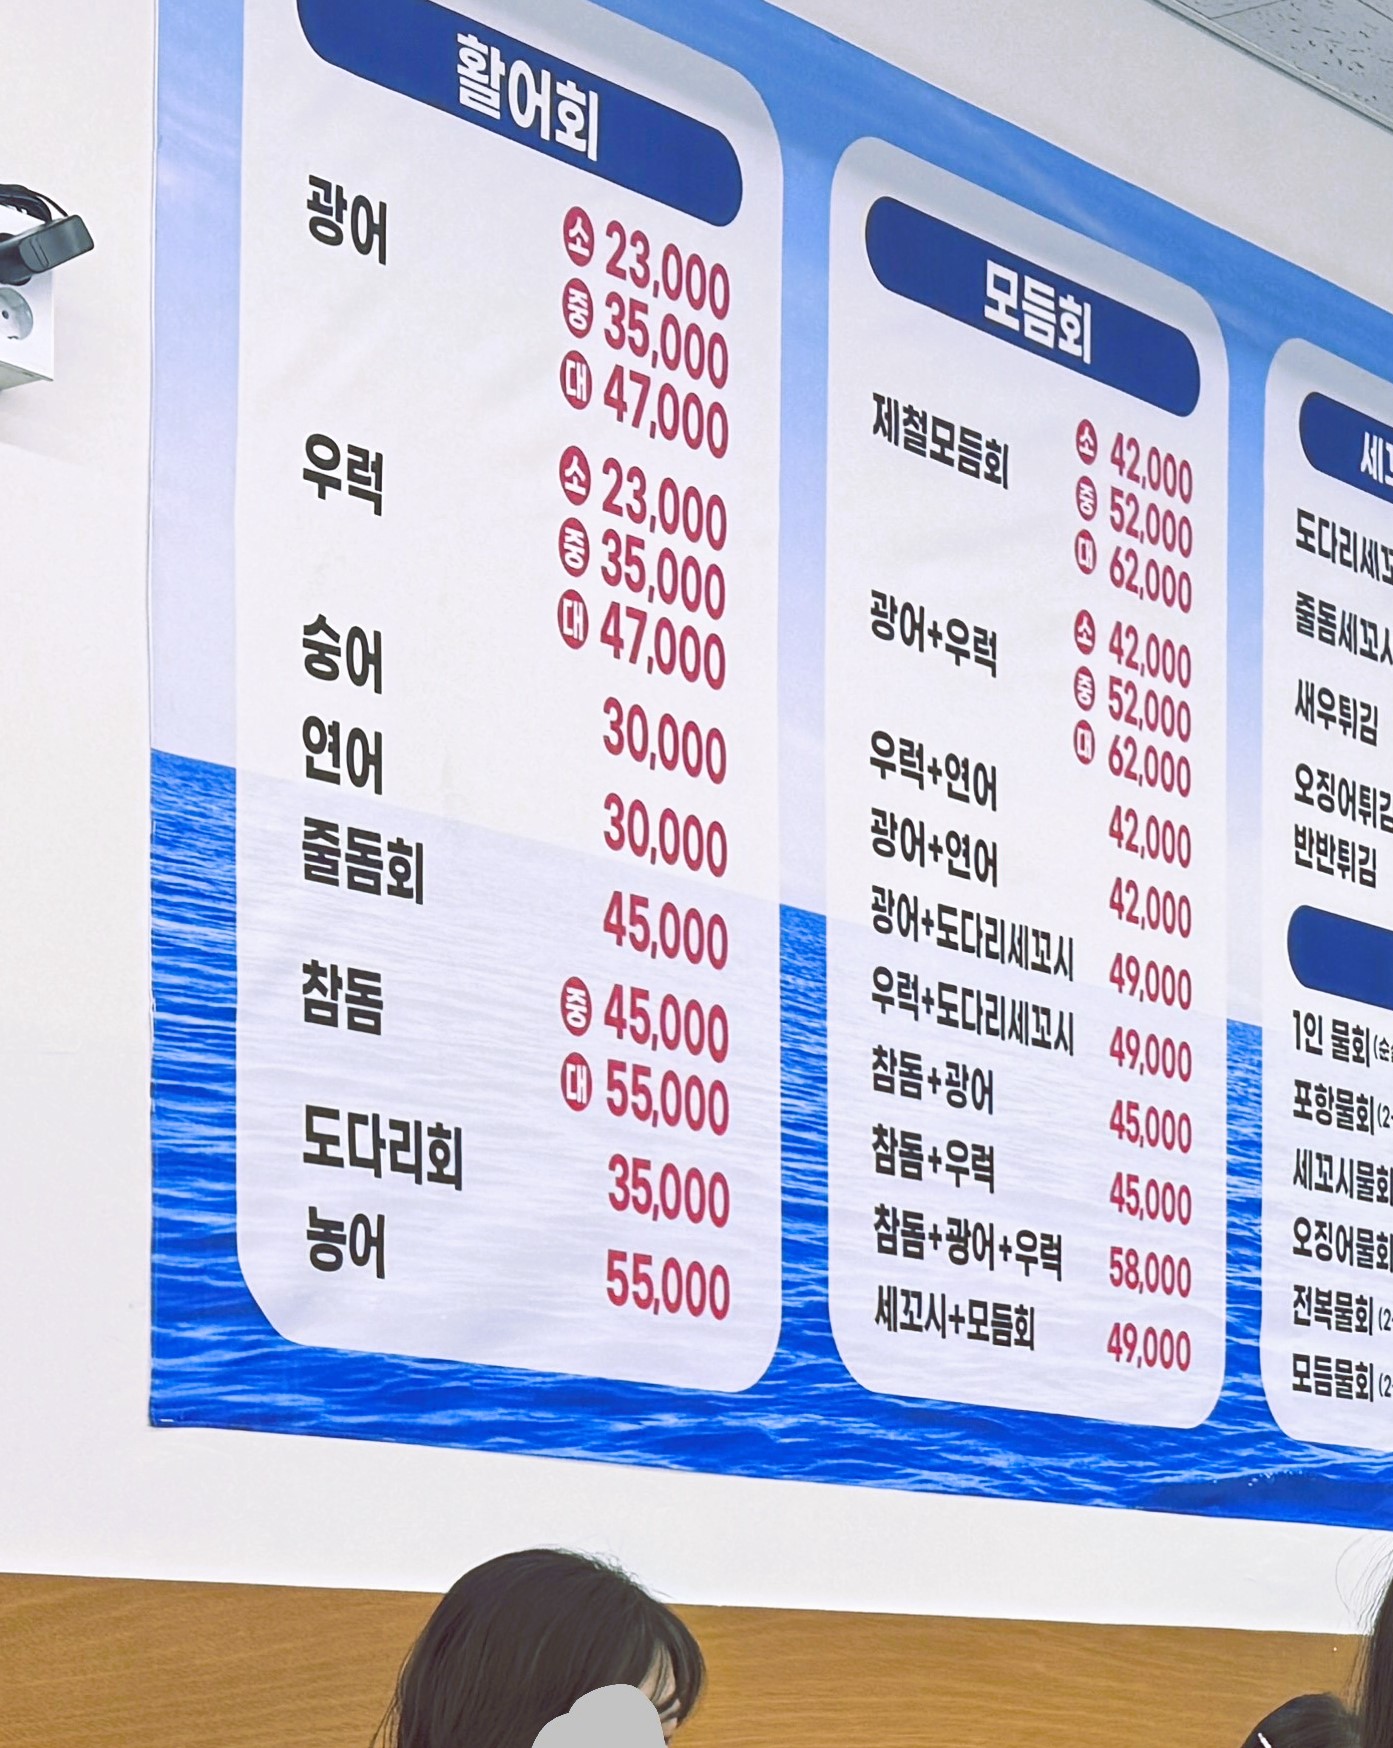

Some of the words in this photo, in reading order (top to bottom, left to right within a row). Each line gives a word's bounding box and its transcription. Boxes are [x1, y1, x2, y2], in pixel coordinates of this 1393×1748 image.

[458, 34, 598, 161] 활어회
[307, 175, 386, 265] 광어
[607, 221, 730, 320] 23,000
[604, 292, 728, 388] 35,000
[985, 260, 1091, 364] 모듬회
[604, 366, 728, 458] 47,000
[873, 393, 1008, 490] 제철모듬회
[1112, 435, 1191, 502] 42,000
[303, 434, 382, 516] 우럭
[603, 459, 726, 551] 23,000
[1112, 488, 1191, 557] 52,000
[602, 529, 726, 619] 35,000
[1111, 549, 1191, 612] 62,000
[601, 603, 725, 690] 47,000
[871, 590, 996, 678] 광어+우럭
[1109, 624, 1190, 688] 42,000
[303, 615, 381, 694] 숭어
[604, 698, 726, 784] 30,000
[1109, 676, 1190, 742] 52,000
[1296, 680, 1377, 746] 새우튀김
[303, 716, 382, 795] 연어
[605, 794, 727, 877] 30,000
[870, 731, 996, 811] 우럭+연어
[1110, 807, 1191, 867] 42,000
[1109, 737, 1190, 797] 62,000
[303, 817, 423, 904] 줄돔회
[604, 892, 728, 970] 45,000
[871, 808, 997, 887] 광어+연어
[1110, 879, 1191, 937] 42,000
[1295, 824, 1376, 888] 반반튀김
[872, 885, 1074, 981] 광어+도다리세꼬시
[1110, 955, 1190, 1009] 49,000
[303, 960, 383, 1035] 참돔
[604, 985, 729, 1063] 45,000
[872, 967, 1074, 1055] 우럭+도다리세꼬시
[1110, 1028, 1192, 1082] 49,000
[1293, 1010, 1322, 1056] 1인
[607, 1060, 729, 1136] 55,000
[873, 1045, 992, 1114] 참돔+광어
[1110, 1102, 1192, 1153] 45,000
[304, 1105, 462, 1190] 도다리회
[609, 1155, 730, 1228] 35,000
[873, 1124, 994, 1193] 참돔+우럭
[1110, 1173, 1191, 1225] 45,000
[307, 1207, 384, 1279] 농어
[607, 1250, 730, 1320] 55,000
[874, 1204, 1062, 1281] 참돔+광어+우럭
[1111, 1247, 1190, 1297] 58,000
[875, 1286, 1034, 1350] 세꼬시+모듬회
[1108, 1324, 1190, 1371] 49,000
